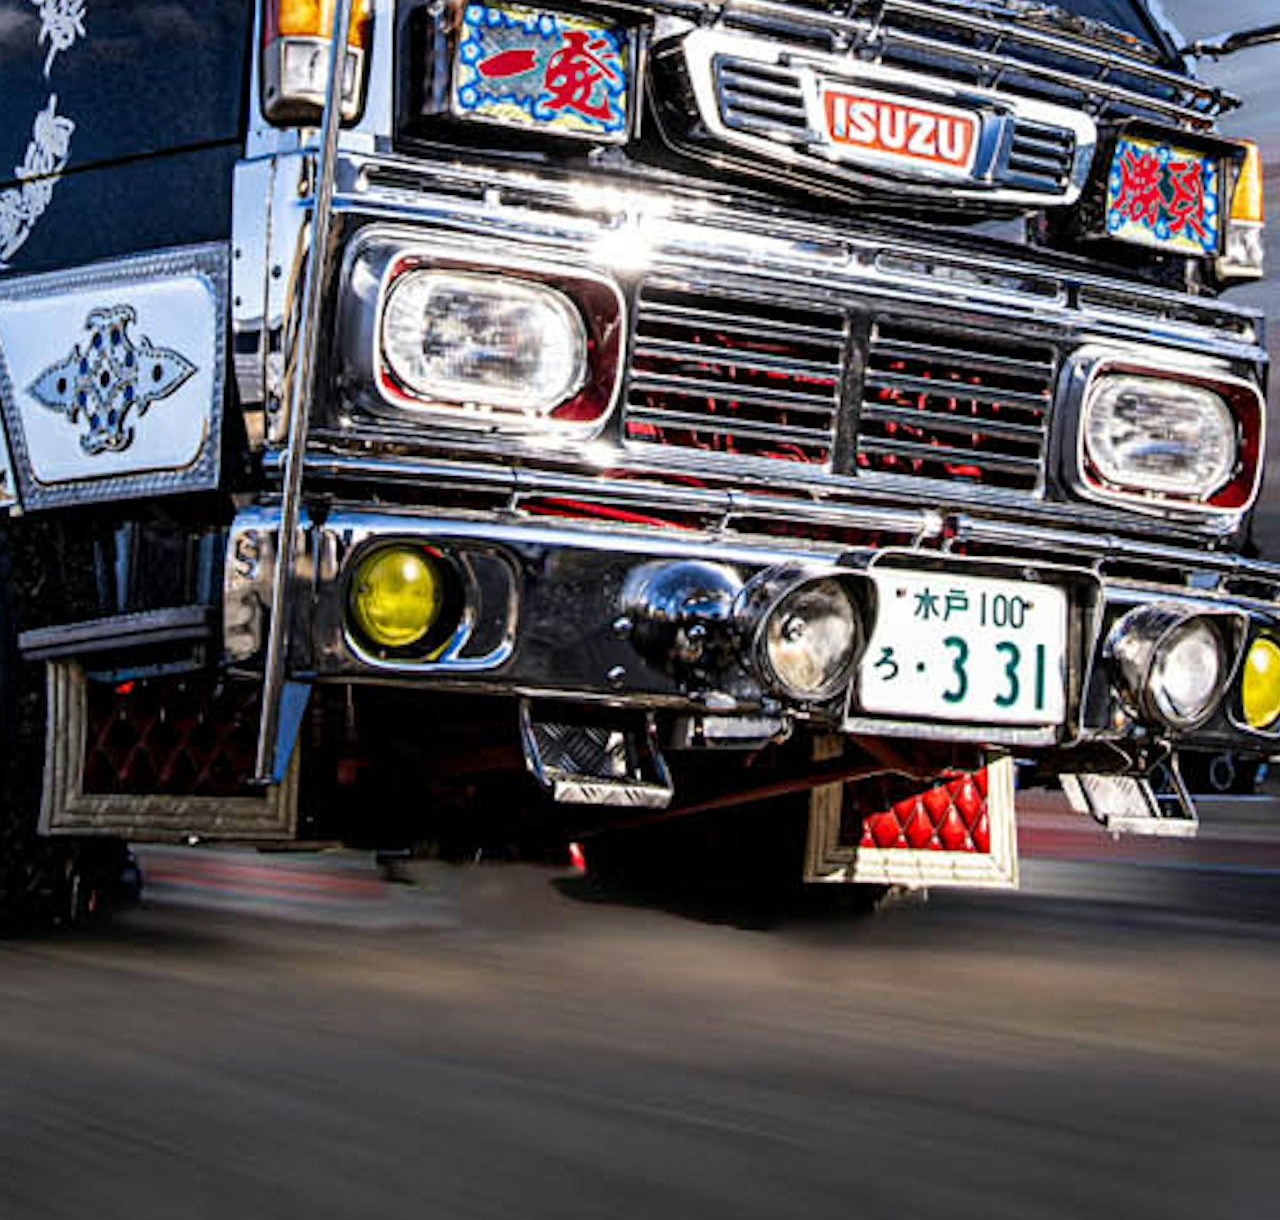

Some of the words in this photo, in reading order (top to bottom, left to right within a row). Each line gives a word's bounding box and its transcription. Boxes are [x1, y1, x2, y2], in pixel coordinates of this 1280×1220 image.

[832, 96, 966, 161] ISUZU
[914, 587, 969, 621] 水戸
[980, 592, 1025, 629] 100
[873, 646, 899, 681] ろ
